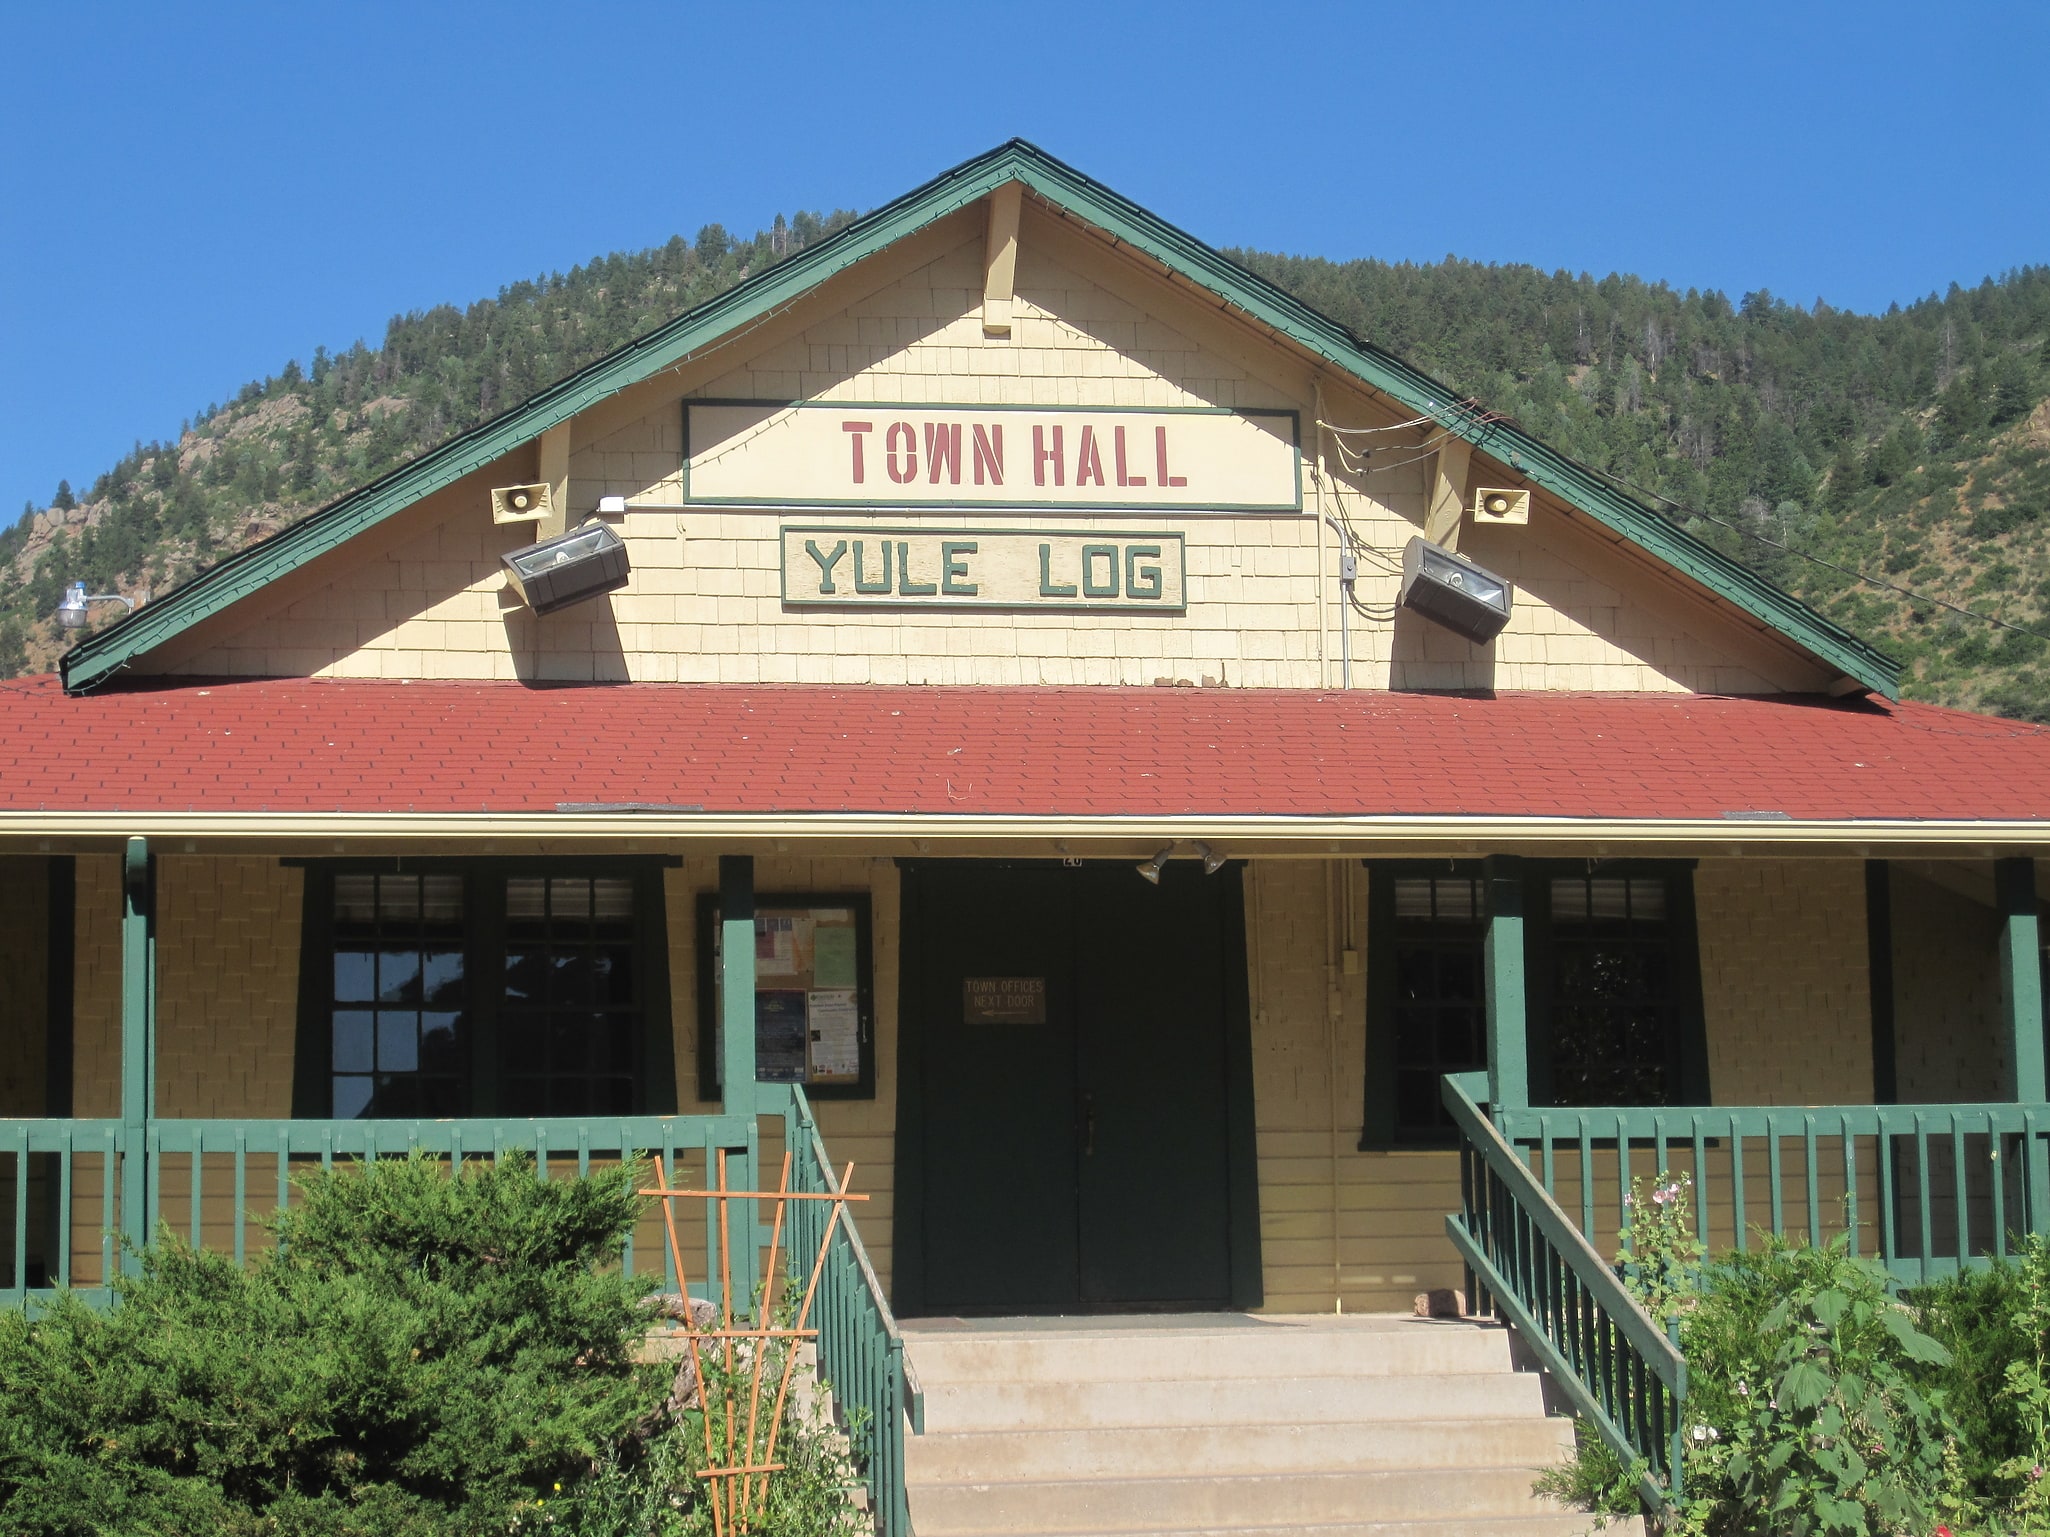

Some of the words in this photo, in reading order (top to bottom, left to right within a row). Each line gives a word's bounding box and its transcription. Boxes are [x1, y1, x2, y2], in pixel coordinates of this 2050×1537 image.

[842, 421, 1004, 486] TOWN
[1033, 424, 1188, 488] HALL
[805, 539, 978, 596] YULE
[1039, 543, 1163, 598] LOG
[966, 980, 996, 993] TOWN
[1001, 980, 1043, 993] OFFICES
[974, 994, 1000, 1008] NEXT
[1007, 994, 1034, 1008] DOOR
